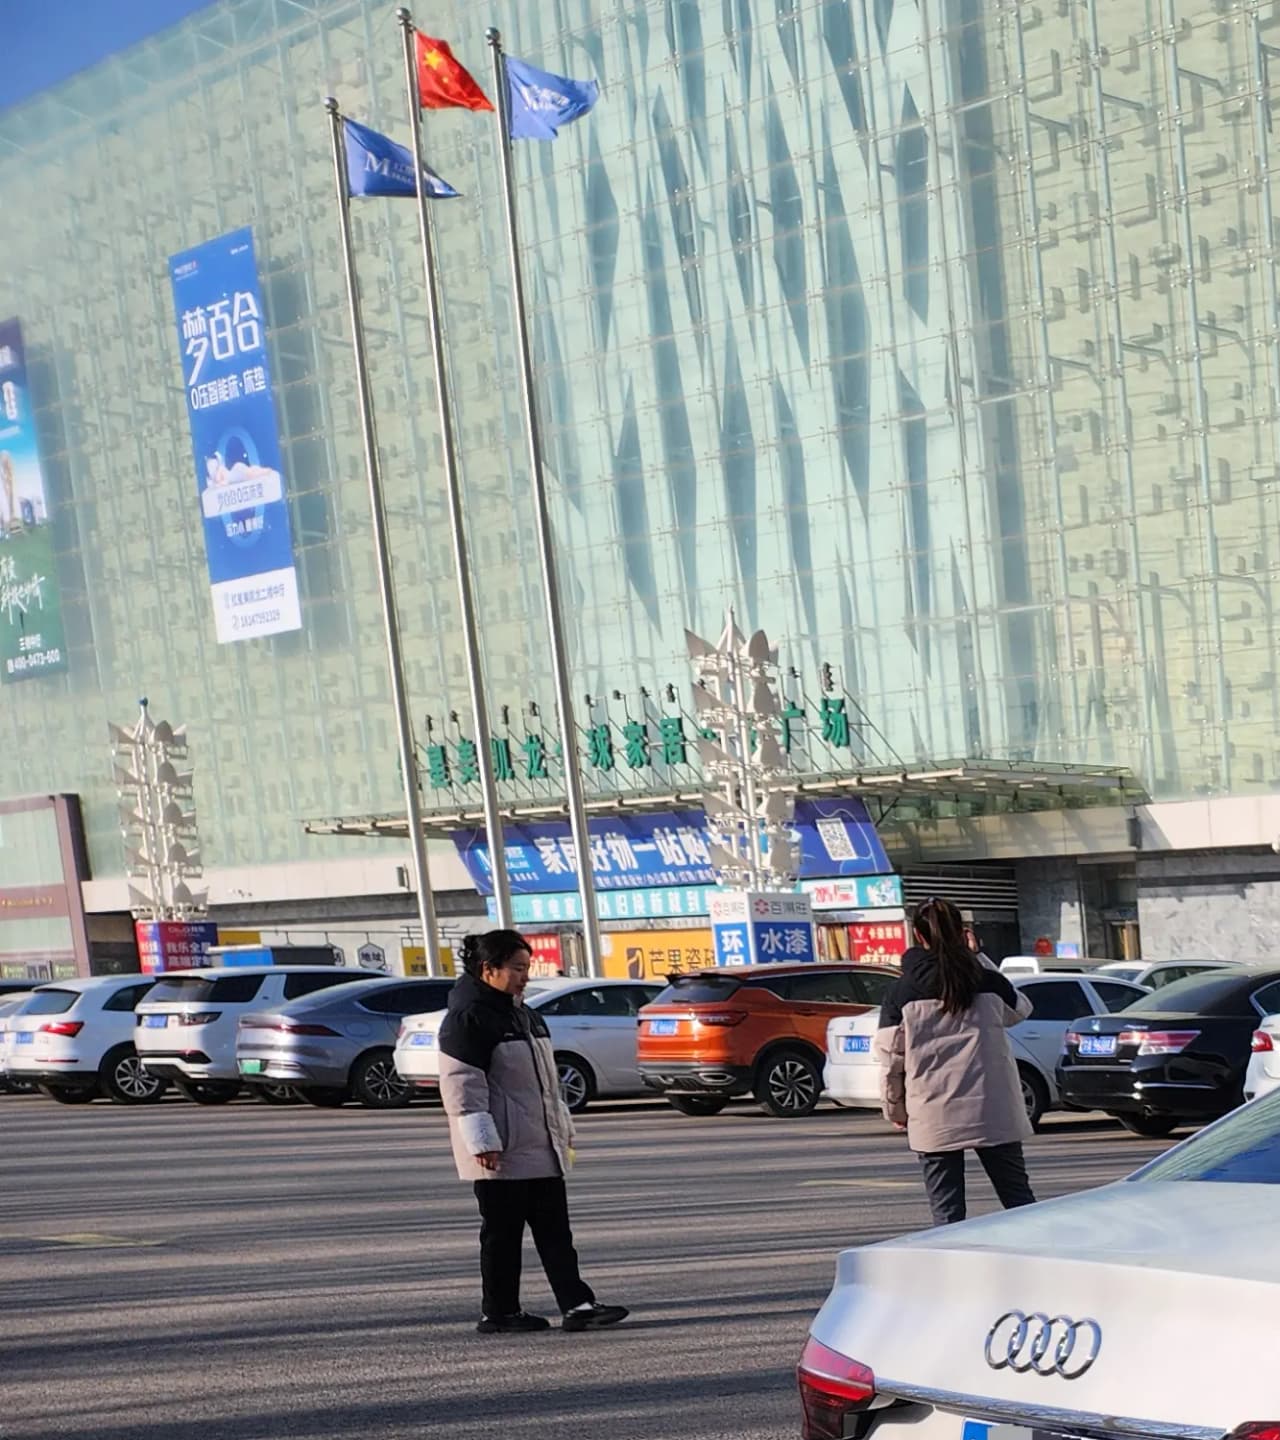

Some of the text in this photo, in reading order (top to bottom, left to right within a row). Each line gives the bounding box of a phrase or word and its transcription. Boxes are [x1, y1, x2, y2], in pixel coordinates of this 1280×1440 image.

[182, 291, 260, 386] 梦百合
[760, 928, 808, 954] 水漆
